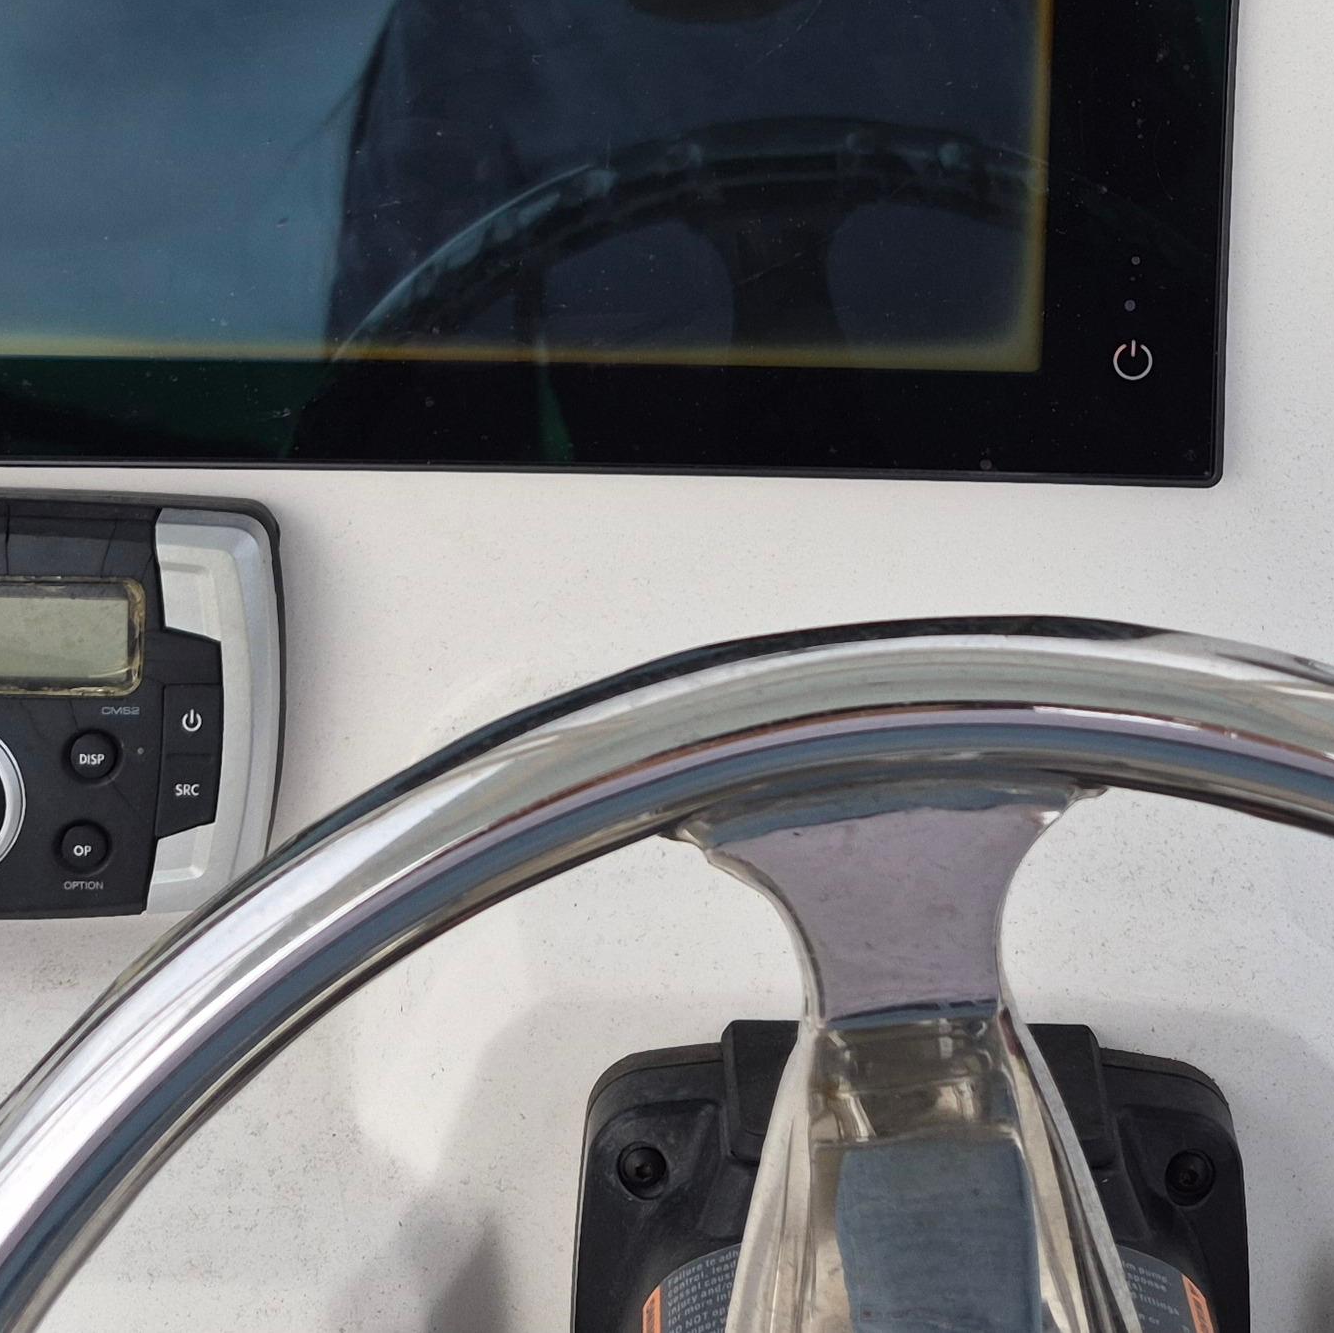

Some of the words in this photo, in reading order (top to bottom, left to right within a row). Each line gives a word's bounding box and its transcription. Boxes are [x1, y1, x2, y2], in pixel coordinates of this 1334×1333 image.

[79, 753, 105, 765] DISP
[175, 784, 200, 796] SRC
[73, 845, 92, 857] OP
[63, 881, 104, 890] OPTION
[685, 1312, 708, 1327] NOT
